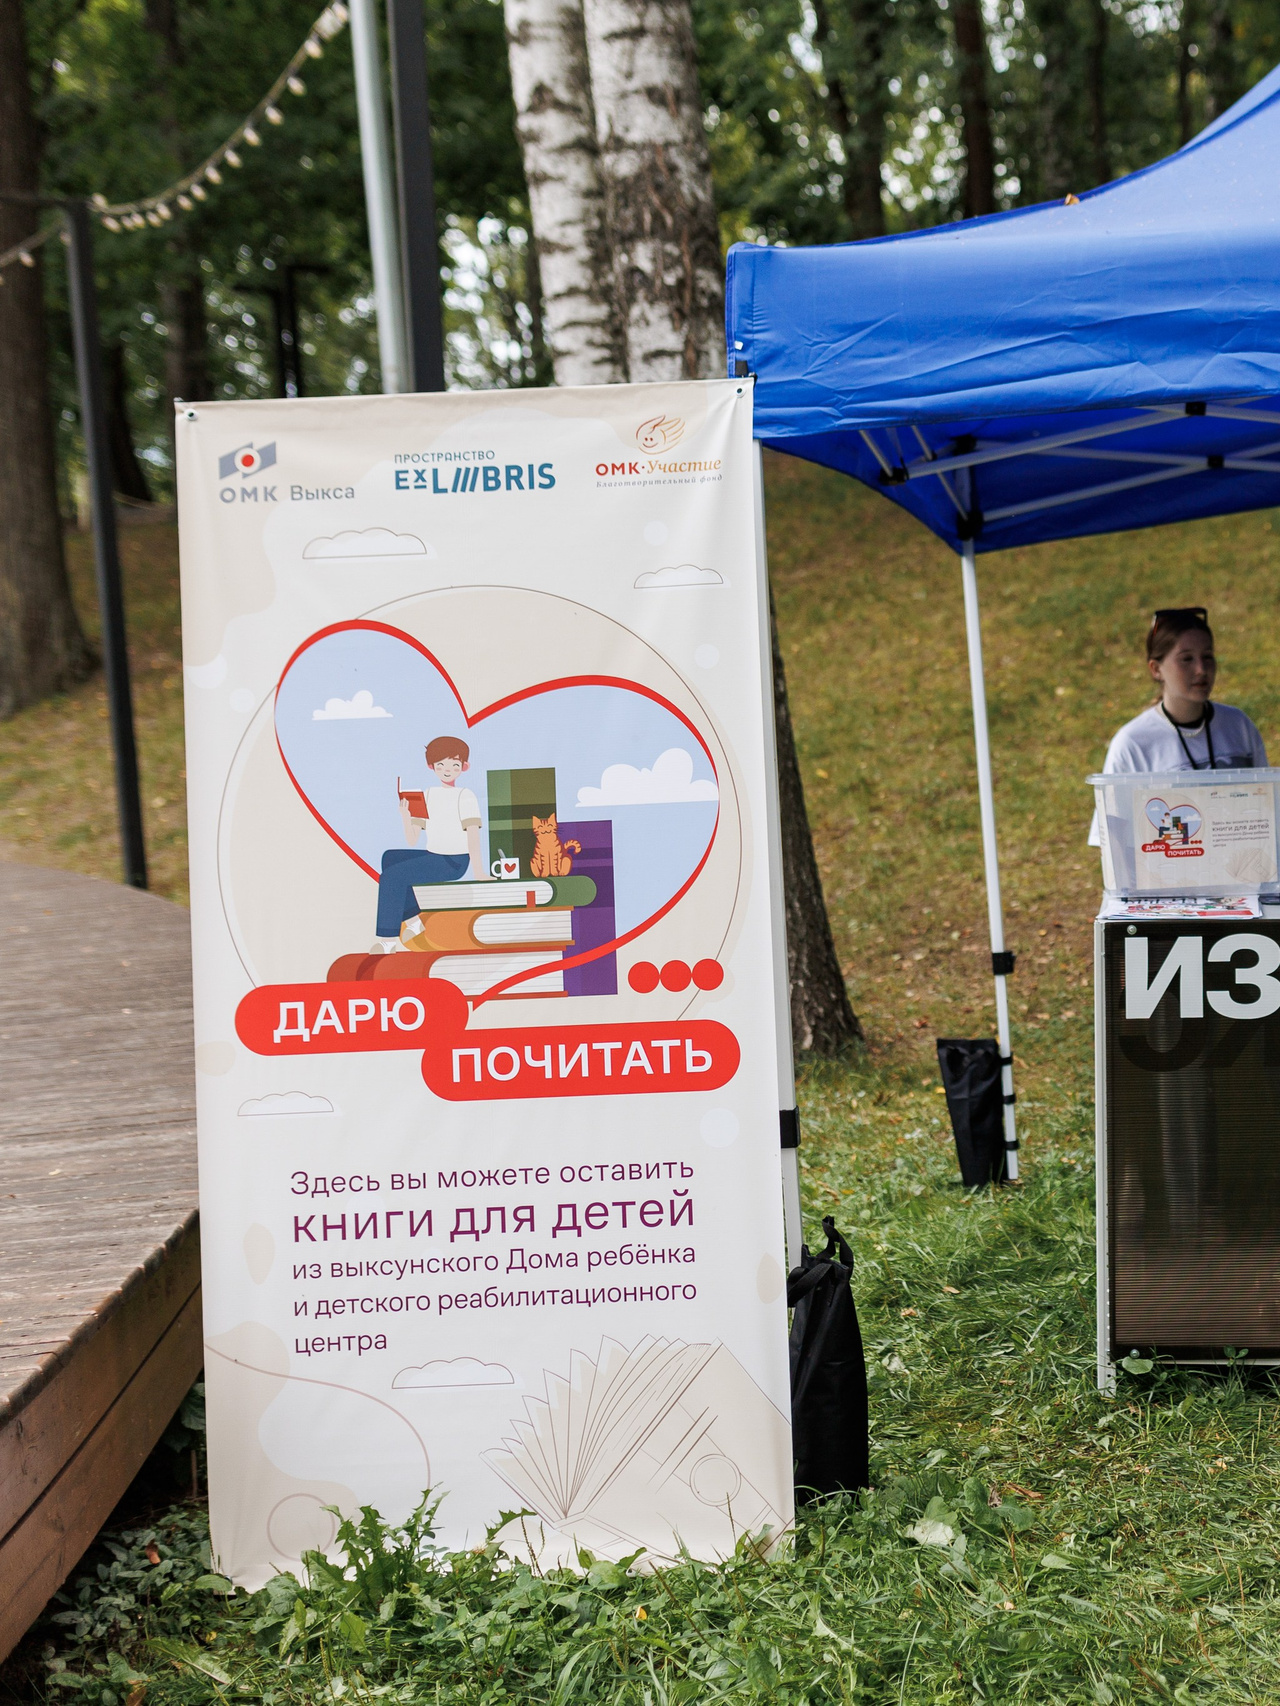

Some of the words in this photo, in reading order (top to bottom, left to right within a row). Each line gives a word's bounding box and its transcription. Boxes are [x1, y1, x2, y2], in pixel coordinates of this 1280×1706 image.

[394, 450, 496, 464] ПРОСТРАНСТВО
[219, 486, 278, 503] ОМК
[290, 485, 355, 501] Выкса
[596, 476, 697, 488] Благотворительный
[699, 474, 723, 485] фонд
[1145, 844, 1166, 852] ДАРЮ
[1167, 849, 1202, 857] ПОЧИТАТЬ
[272, 996, 425, 1043] ДАРЮ
[451, 1038, 714, 1083] ПОЧИТАТЬ
[290, 1171, 380, 1198] Здесь
[391, 1172, 427, 1190] вы
[438, 1167, 550, 1189] можете
[559, 1161, 694, 1183] оставить
[294, 1209, 433, 1243] книги
[449, 1205, 535, 1243] для
[552, 1189, 694, 1239] детей
[293, 1263, 322, 1280] из
[330, 1255, 499, 1281] выксунского
[506, 1248, 579, 1275] Дома
[587, 1243, 696, 1273] ребёнка
[294, 1301, 308, 1317] и
[314, 1294, 431, 1319] детского
[438, 1284, 697, 1316] реабилитационного
[295, 1333, 387, 1356] центра
